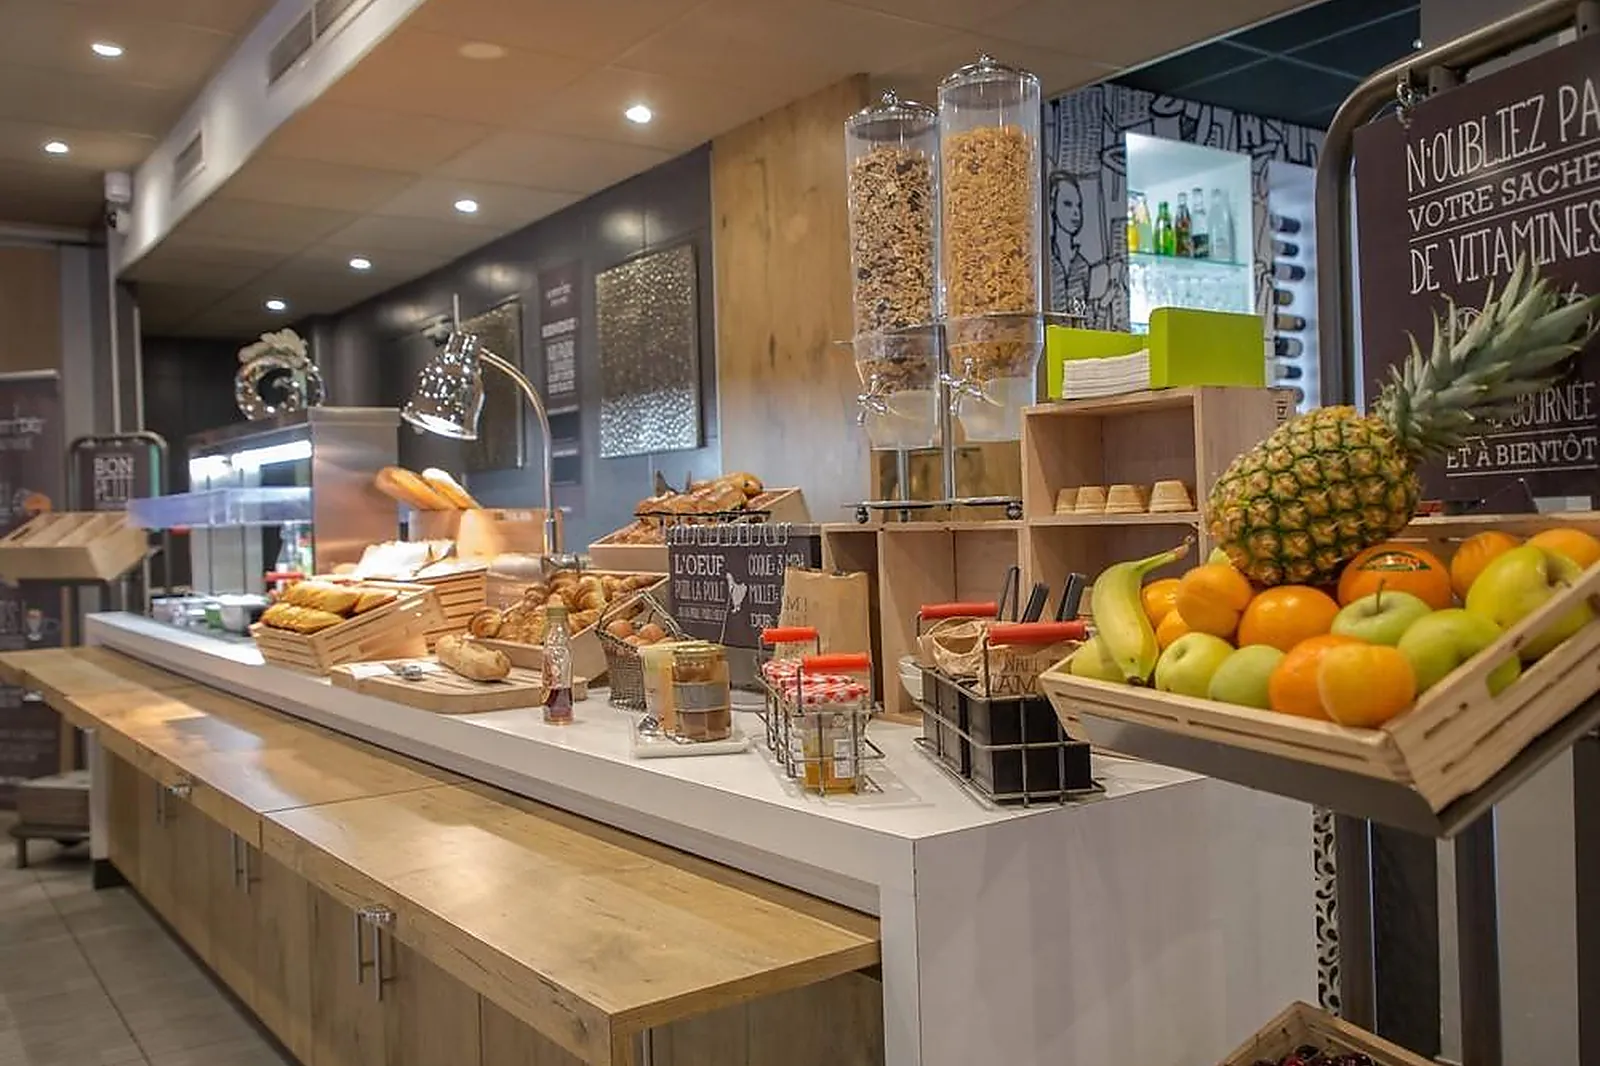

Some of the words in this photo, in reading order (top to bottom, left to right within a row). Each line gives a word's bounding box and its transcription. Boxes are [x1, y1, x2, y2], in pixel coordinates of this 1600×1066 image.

[1406, 94, 1547, 192] N'OUBLIEZ
[1407, 184, 1494, 232] VOTRE
[1501, 151, 1600, 206] SACHE
[1409, 243, 1440, 295] DE
[1448, 199, 1600, 284] VITAMINES
[94, 456, 134, 475] BON
[1446, 447, 1472, 469] ET
[1476, 440, 1492, 467] À
[1496, 432, 1599, 466] BIENTÔT
[674, 553, 726, 576] L'OEUF
